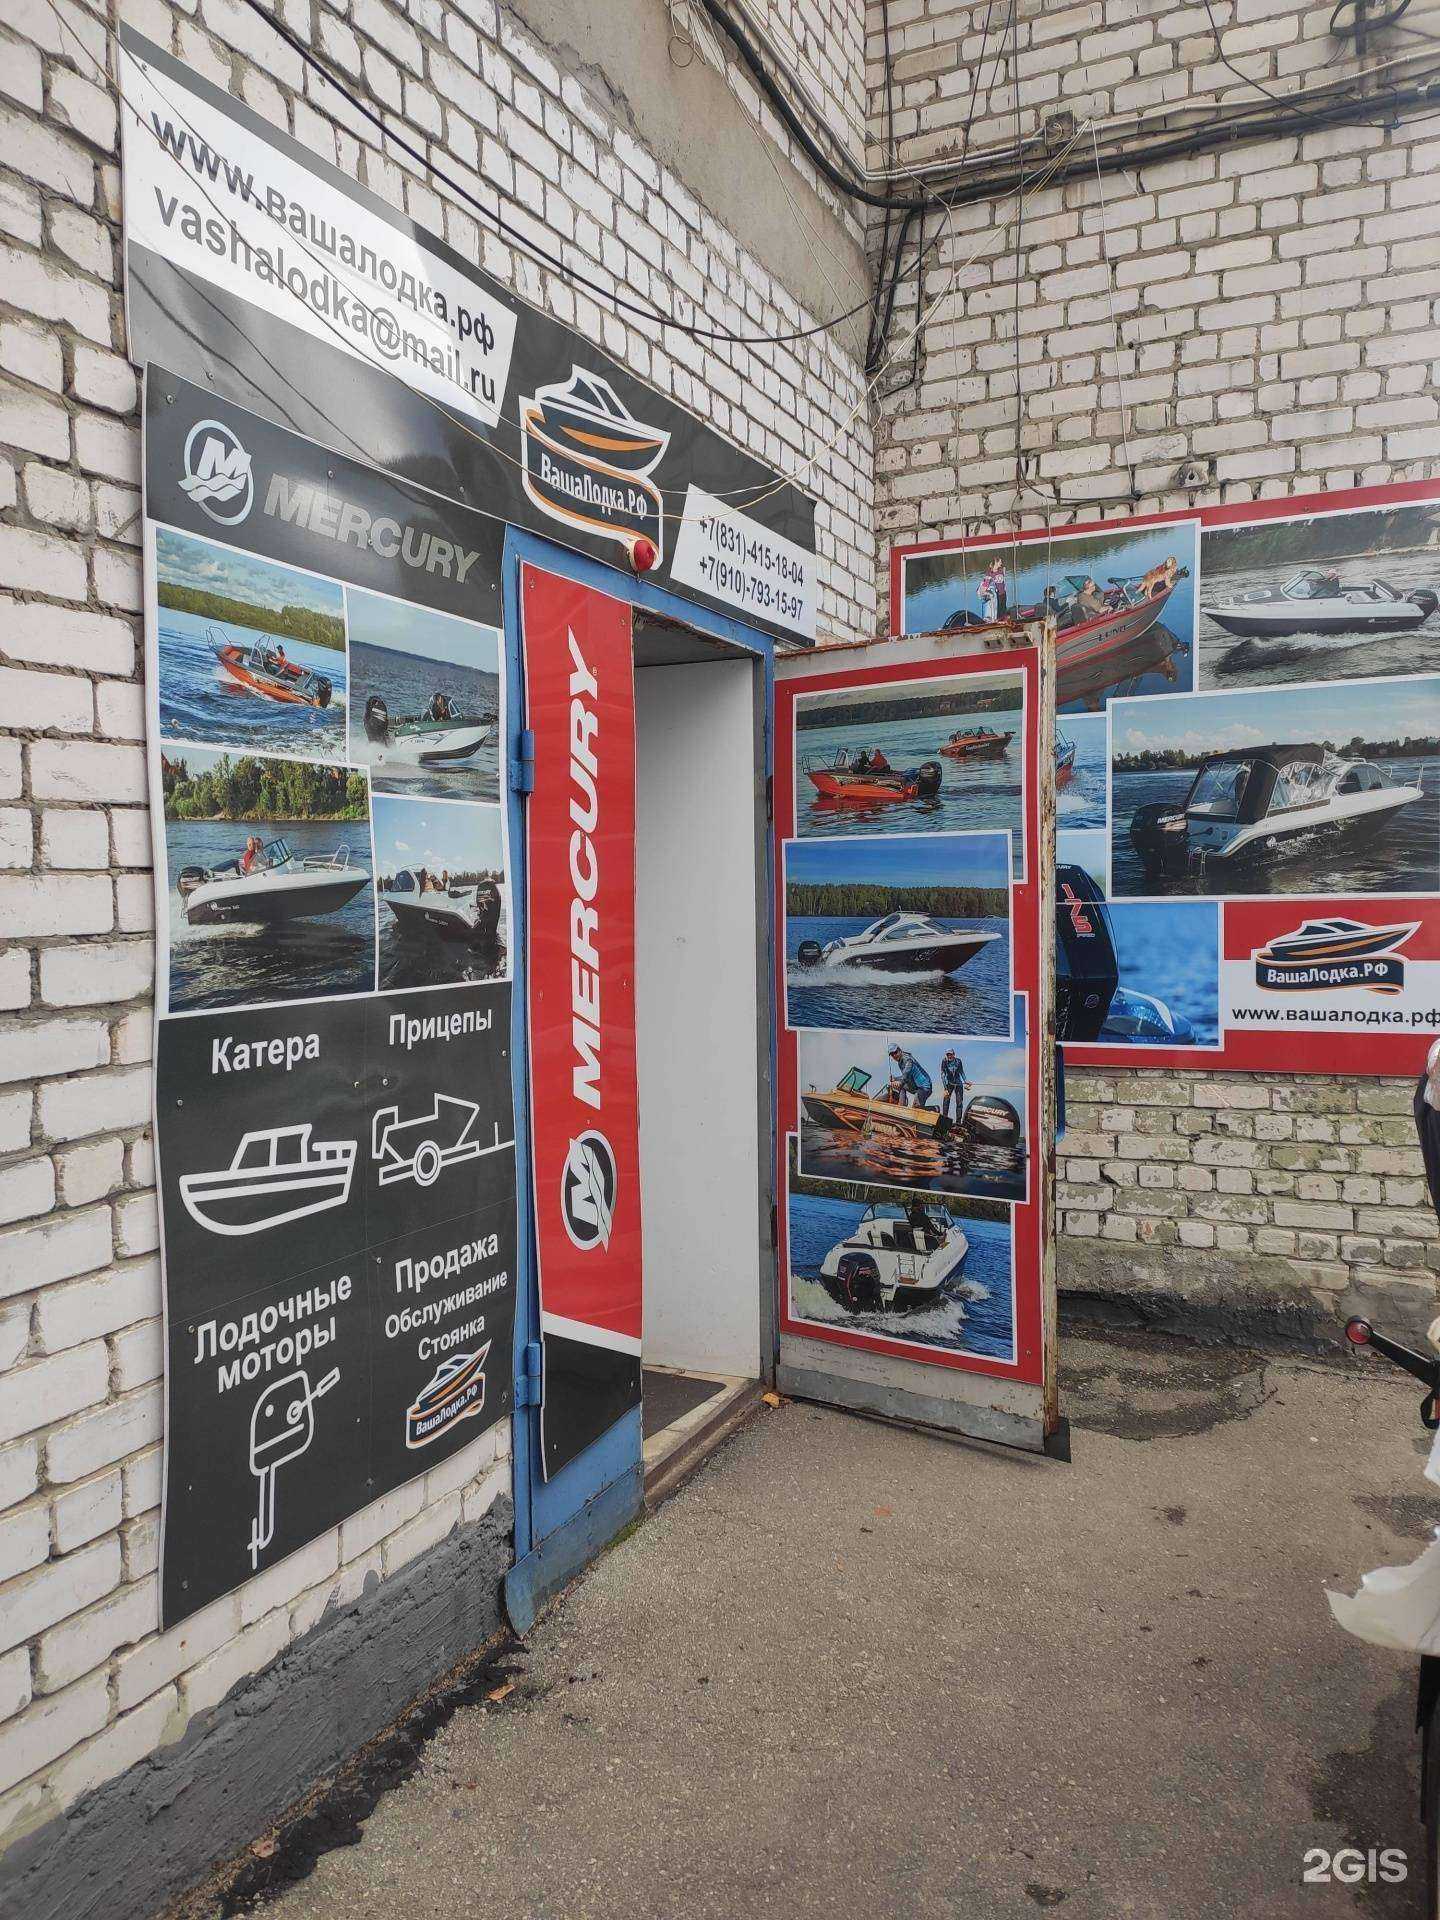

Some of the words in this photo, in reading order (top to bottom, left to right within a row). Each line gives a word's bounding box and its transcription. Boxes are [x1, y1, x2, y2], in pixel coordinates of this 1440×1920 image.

[151, 111, 495, 356] www.вашалодка.рф
[153, 185, 497, 405] vashalodka@mail.ru
[541, 452, 648, 521] ВашаЛодка.РФ
[263, 473, 480, 583] MERCURY
[699, 517, 804, 584] +7(831)-415-18-04
[699, 556, 804, 622] +7(910)-793-15-97
[568, 625, 601, 1110] MERCURY
[1267, 963, 1389, 983] ВашаЛодка.РФ
[389, 1009, 493, 1050] Прицепы
[1231, 1007, 1440, 1027] www.вашалодка.рф
[211, 1033, 320, 1074] Катера
[394, 1232, 499, 1294] Продажа
[194, 1274, 352, 1364] Лодочные
[384, 1269, 508, 1338] Обслуживание
[217, 1317, 336, 1394] моторы
[417, 1314, 485, 1361] Стоянка
[415, 1383, 478, 1436] ВашаЛодка.РФ
